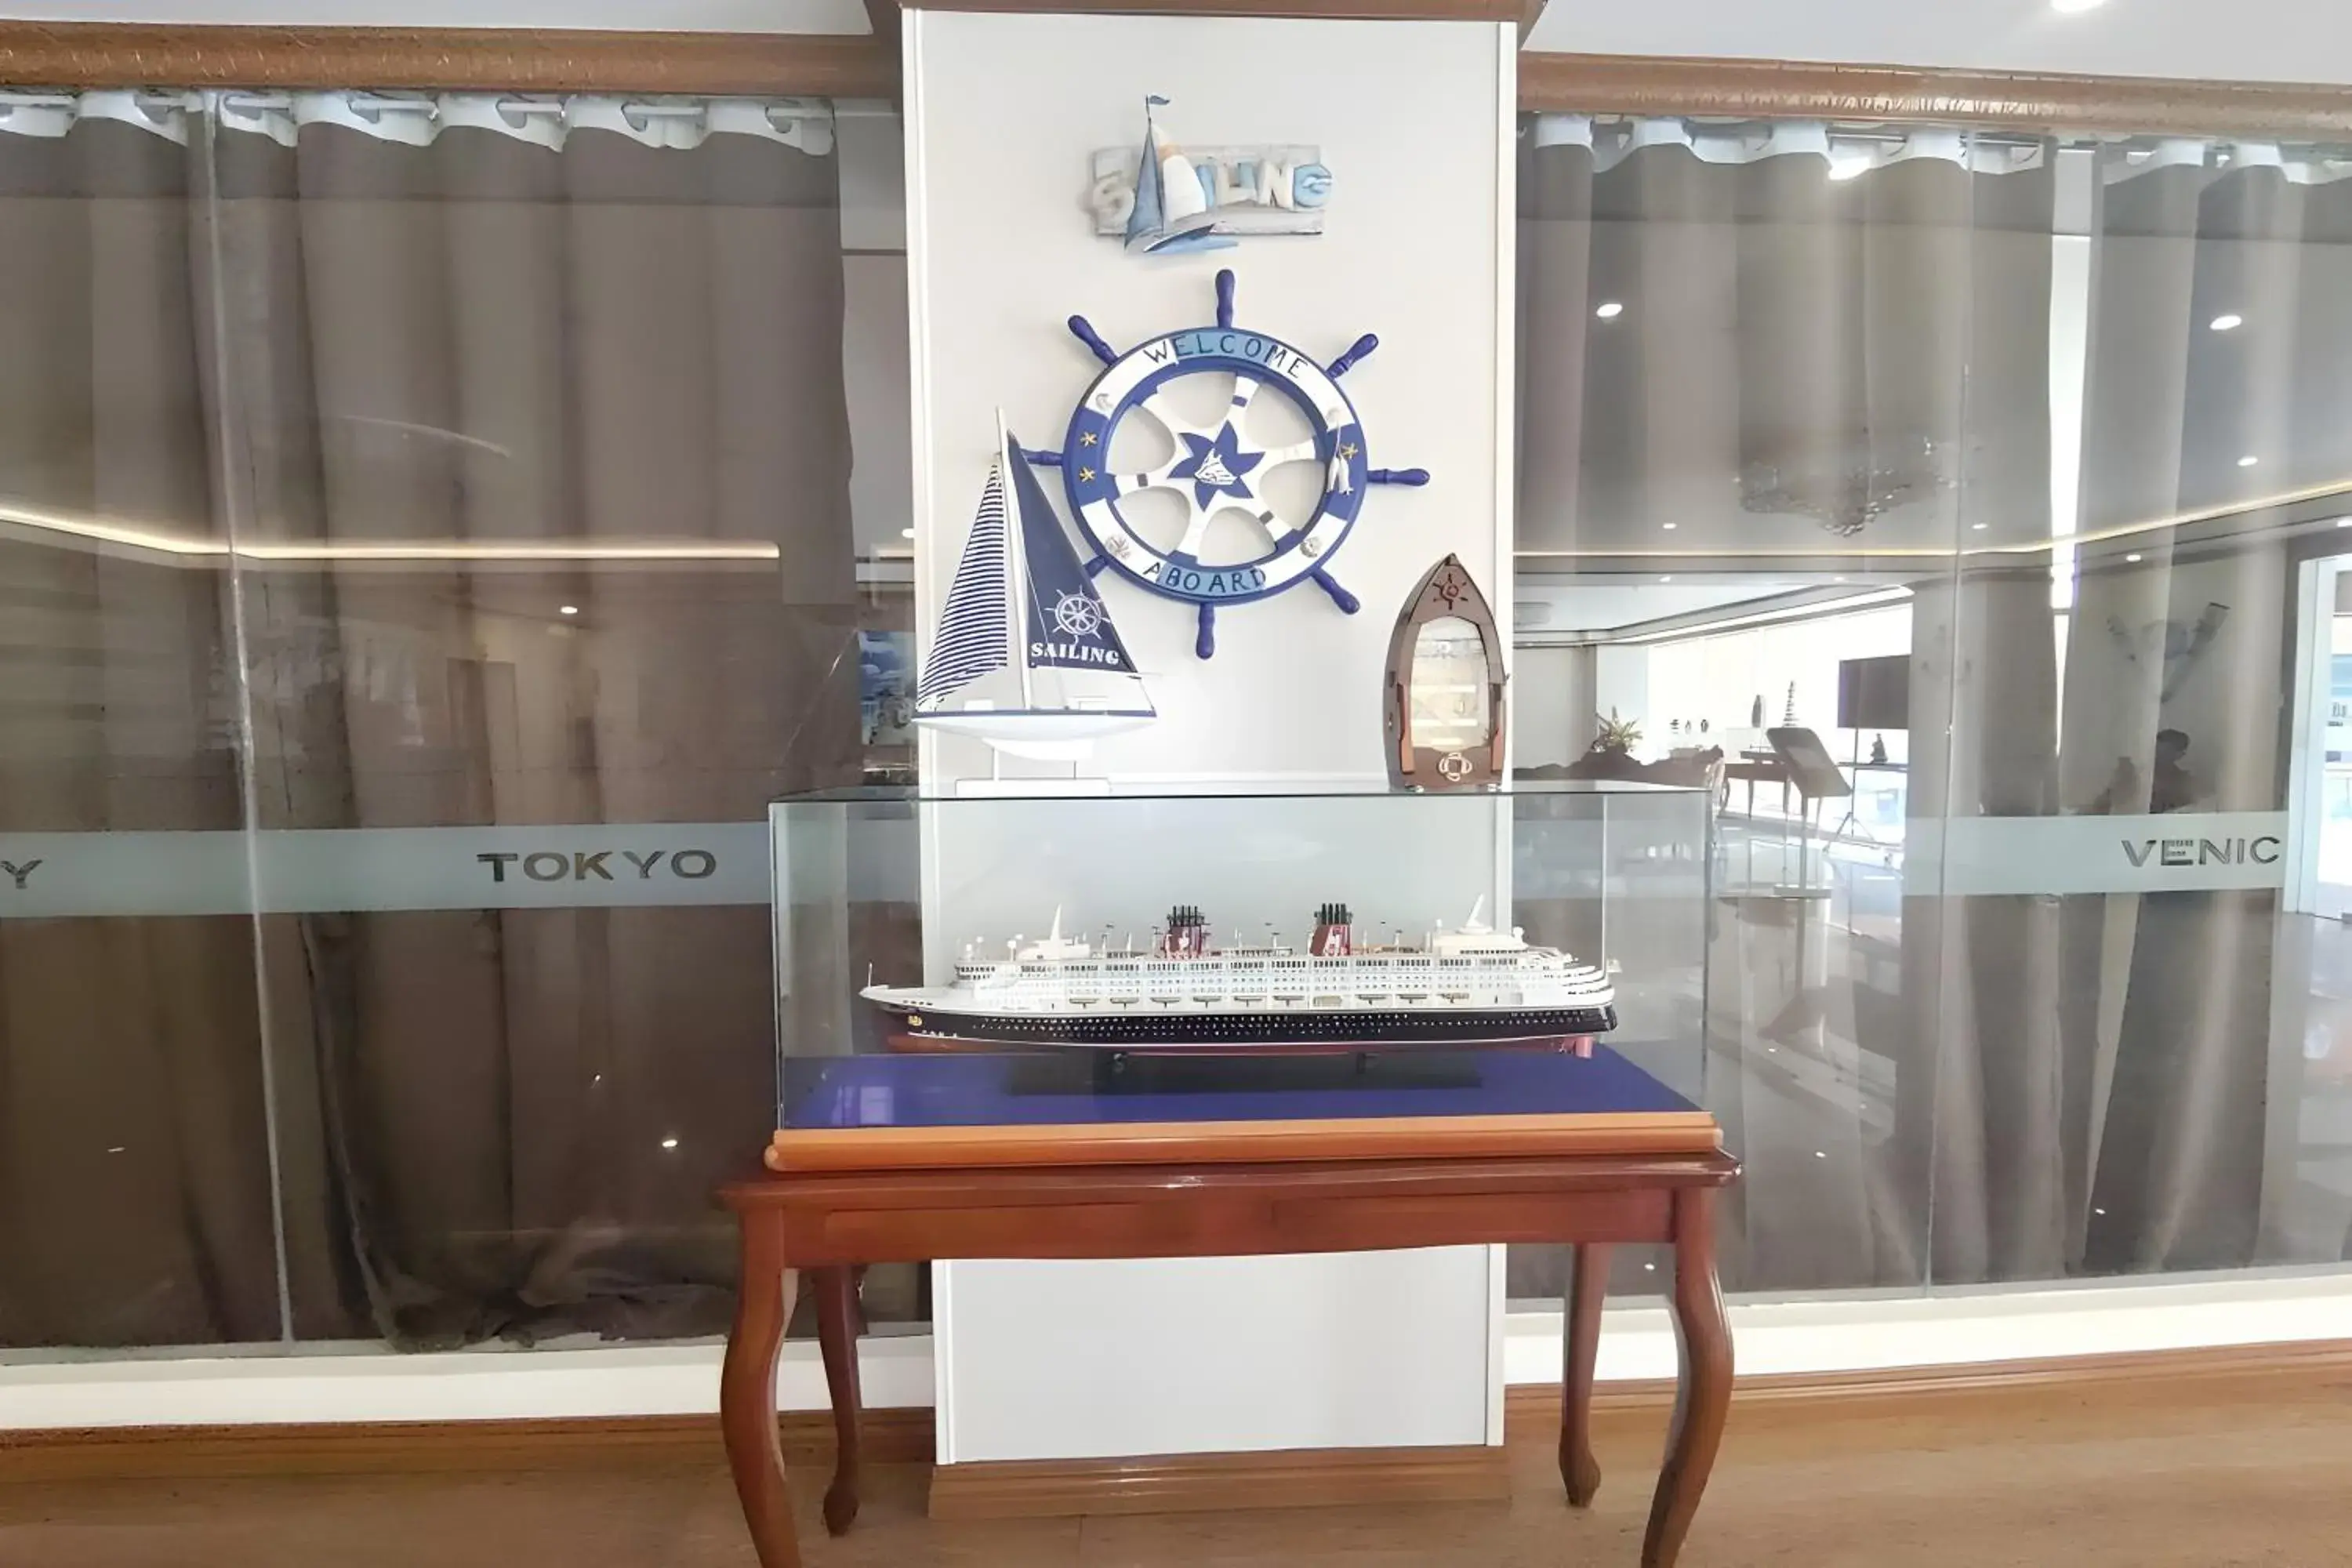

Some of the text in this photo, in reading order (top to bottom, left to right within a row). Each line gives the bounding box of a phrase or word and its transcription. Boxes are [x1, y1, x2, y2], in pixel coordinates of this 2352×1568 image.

[1142, 332, 1308, 379] WELCOME
[1142, 561, 1266, 593] ABOARD
[1030, 641, 1120, 666] SAILING
[477, 849, 717, 882] TOKYO
